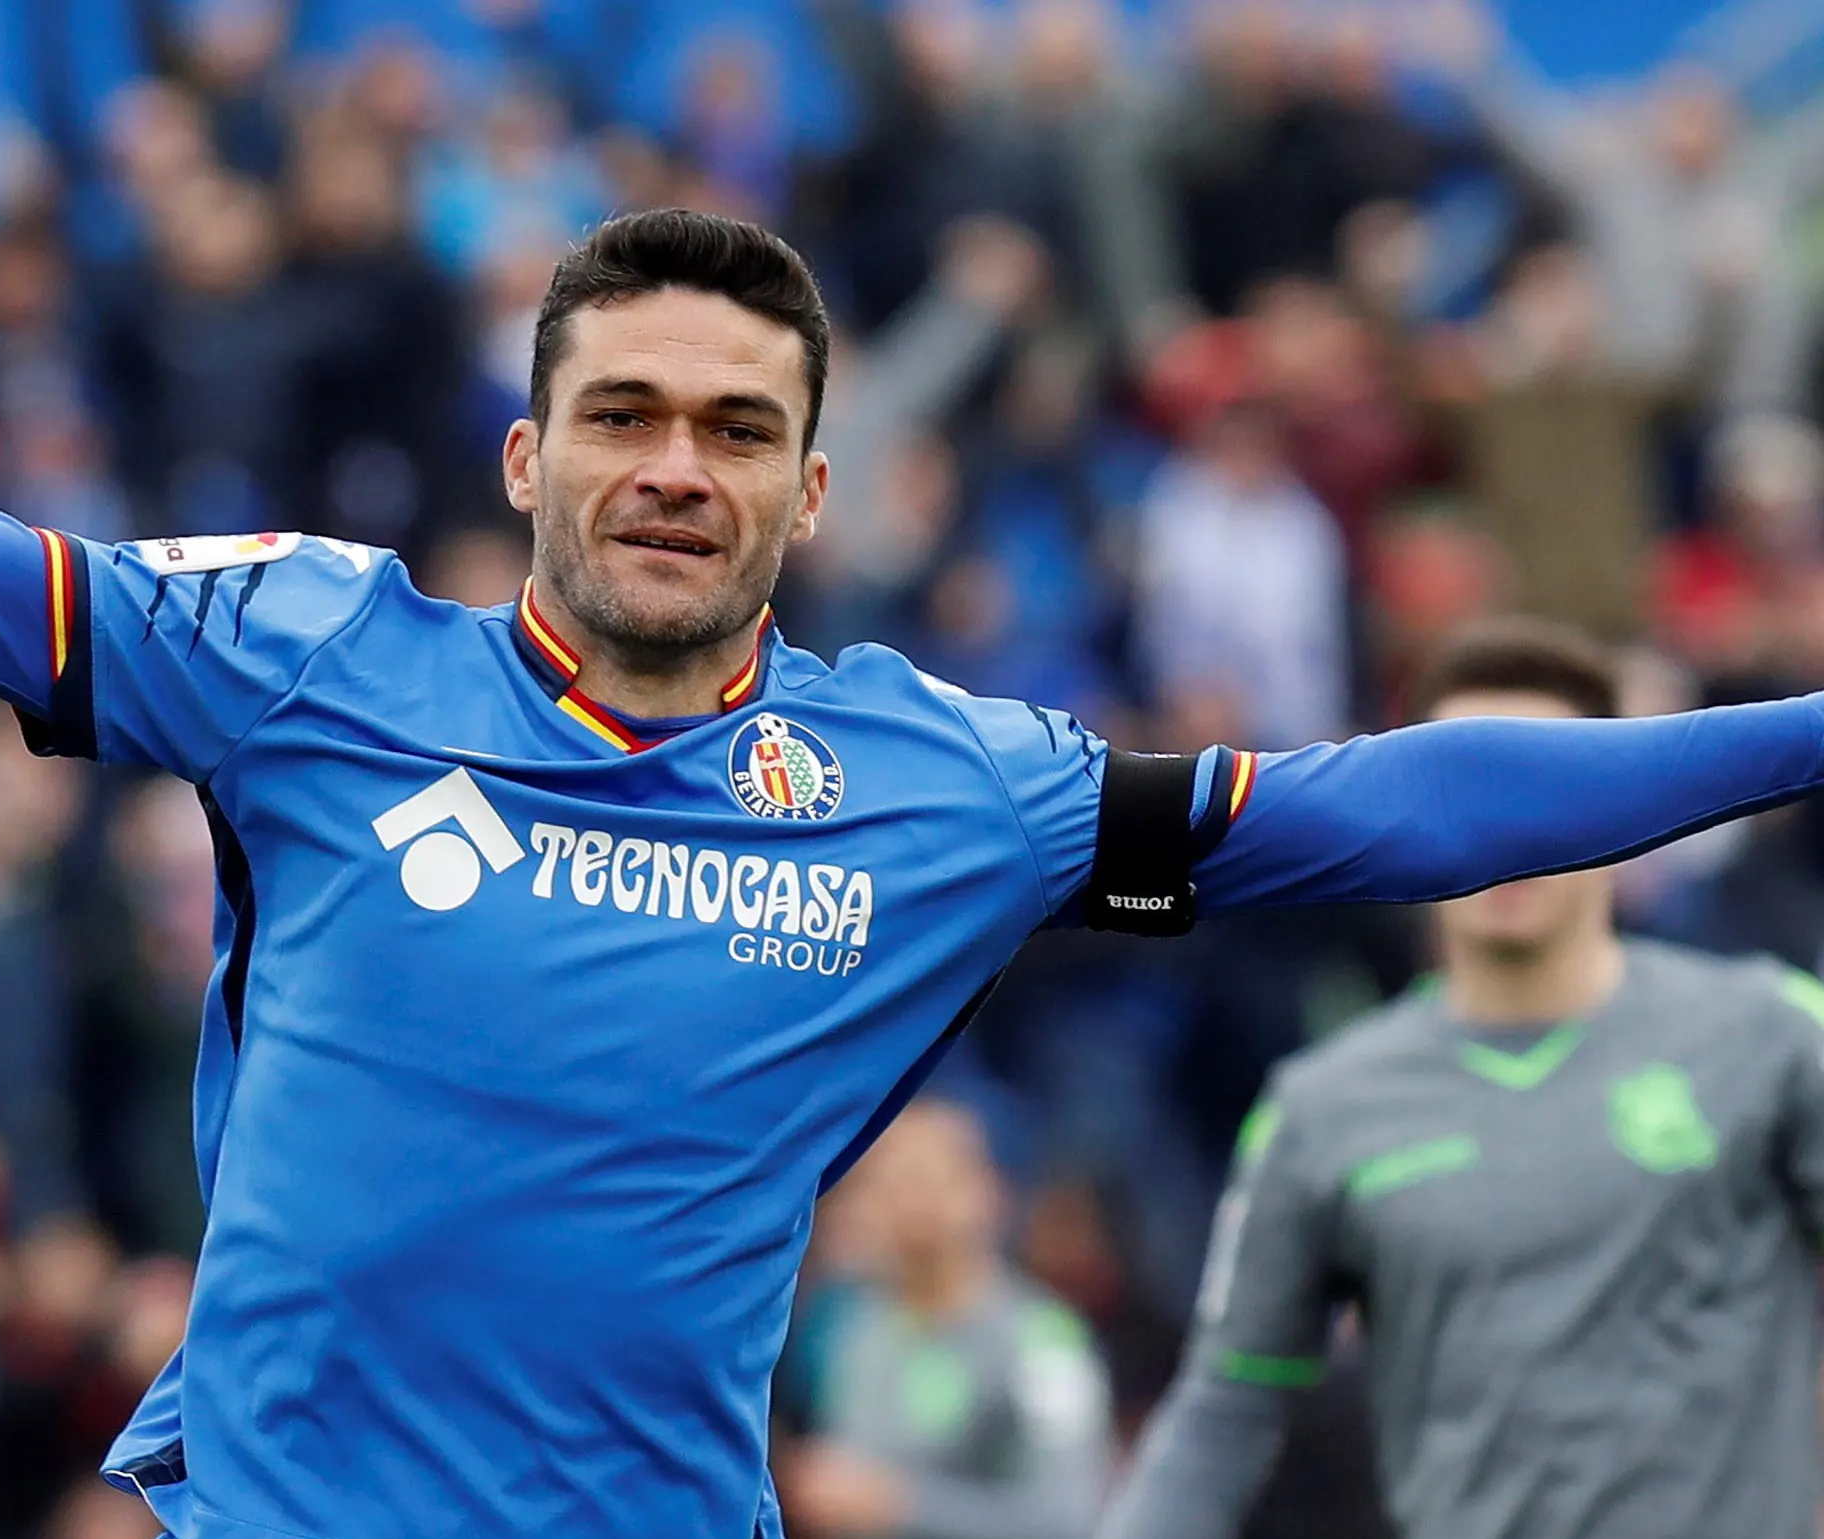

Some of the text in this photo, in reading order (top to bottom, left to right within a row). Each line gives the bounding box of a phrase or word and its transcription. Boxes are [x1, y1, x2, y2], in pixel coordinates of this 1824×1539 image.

[733, 770, 785, 820] GETAFE
[530, 821, 873, 947] TECNOCASA
[728, 932, 863, 978] GROUP
